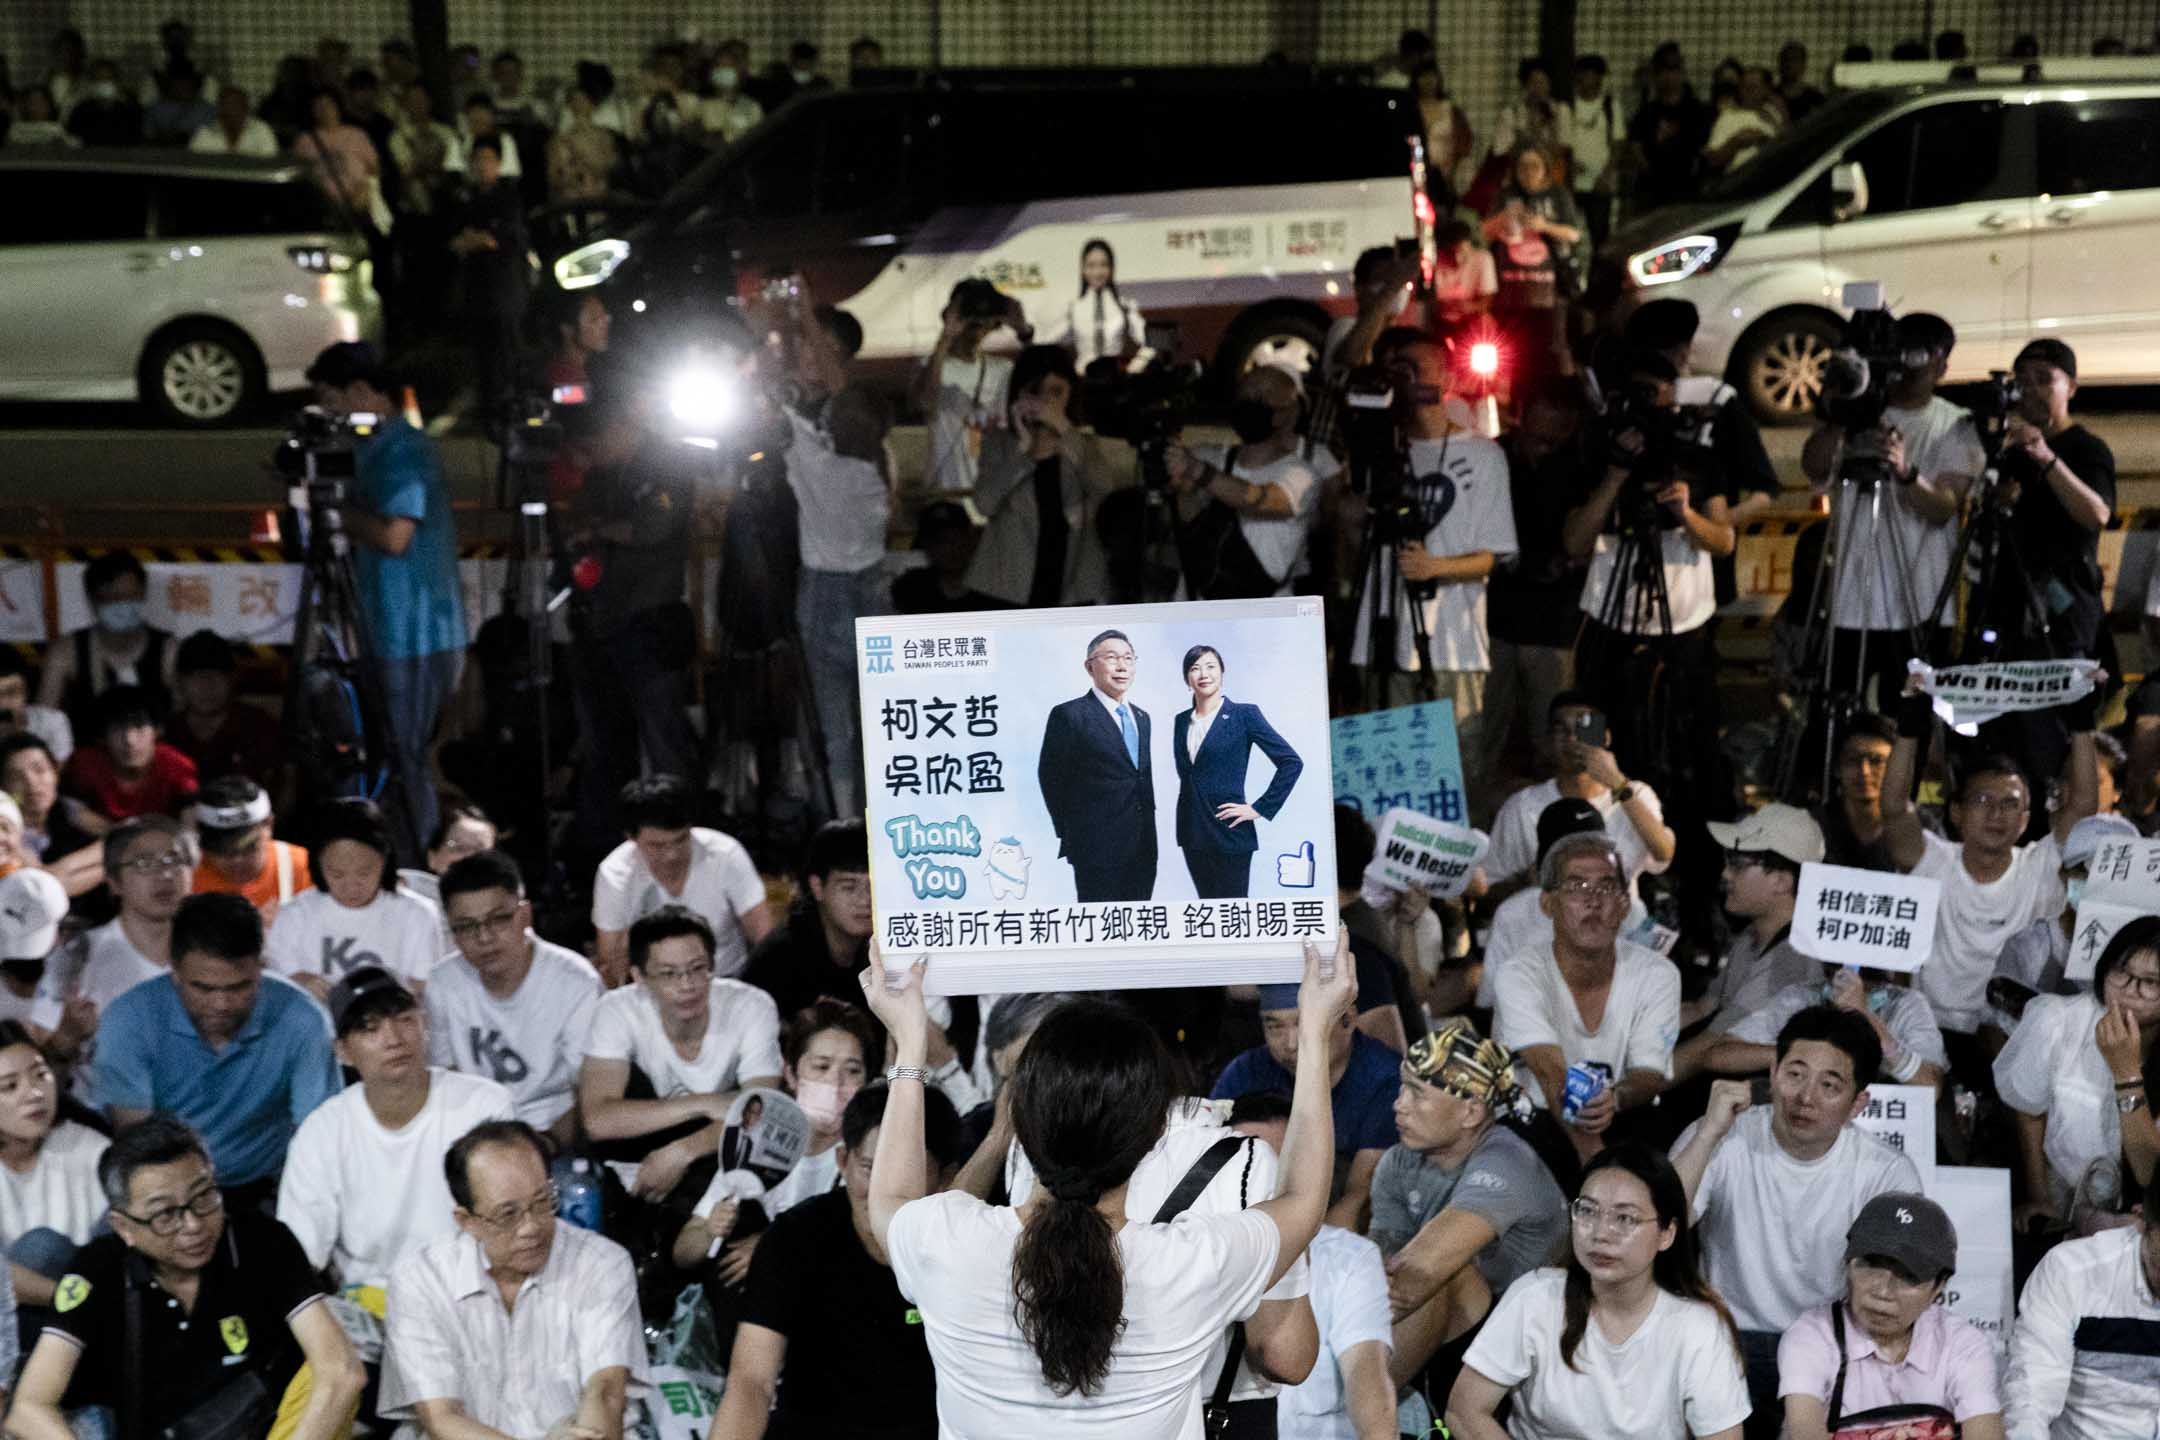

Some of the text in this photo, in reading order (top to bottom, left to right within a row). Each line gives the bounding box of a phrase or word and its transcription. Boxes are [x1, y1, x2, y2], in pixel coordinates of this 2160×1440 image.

[903, 637, 987, 659] 台灣民眾黨
[904, 659, 989, 669] TAIWAN PEOPLE'S PARTY
[1935, 673, 2072, 692] We Resist
[881, 694, 999, 741] 柯文哲
[885, 751, 1005, 797] 吳欣盈
[886, 816, 979, 855] Thank
[1385, 839, 1415, 866] We
[1416, 851, 1470, 878] Resist
[907, 860, 964, 896] You
[1817, 887, 1919, 921] 相信清白
[886, 900, 1326, 948] 感謝所有新竹鄉親 銘謝賜票
[1816, 917, 1912, 950] 柯P加油
